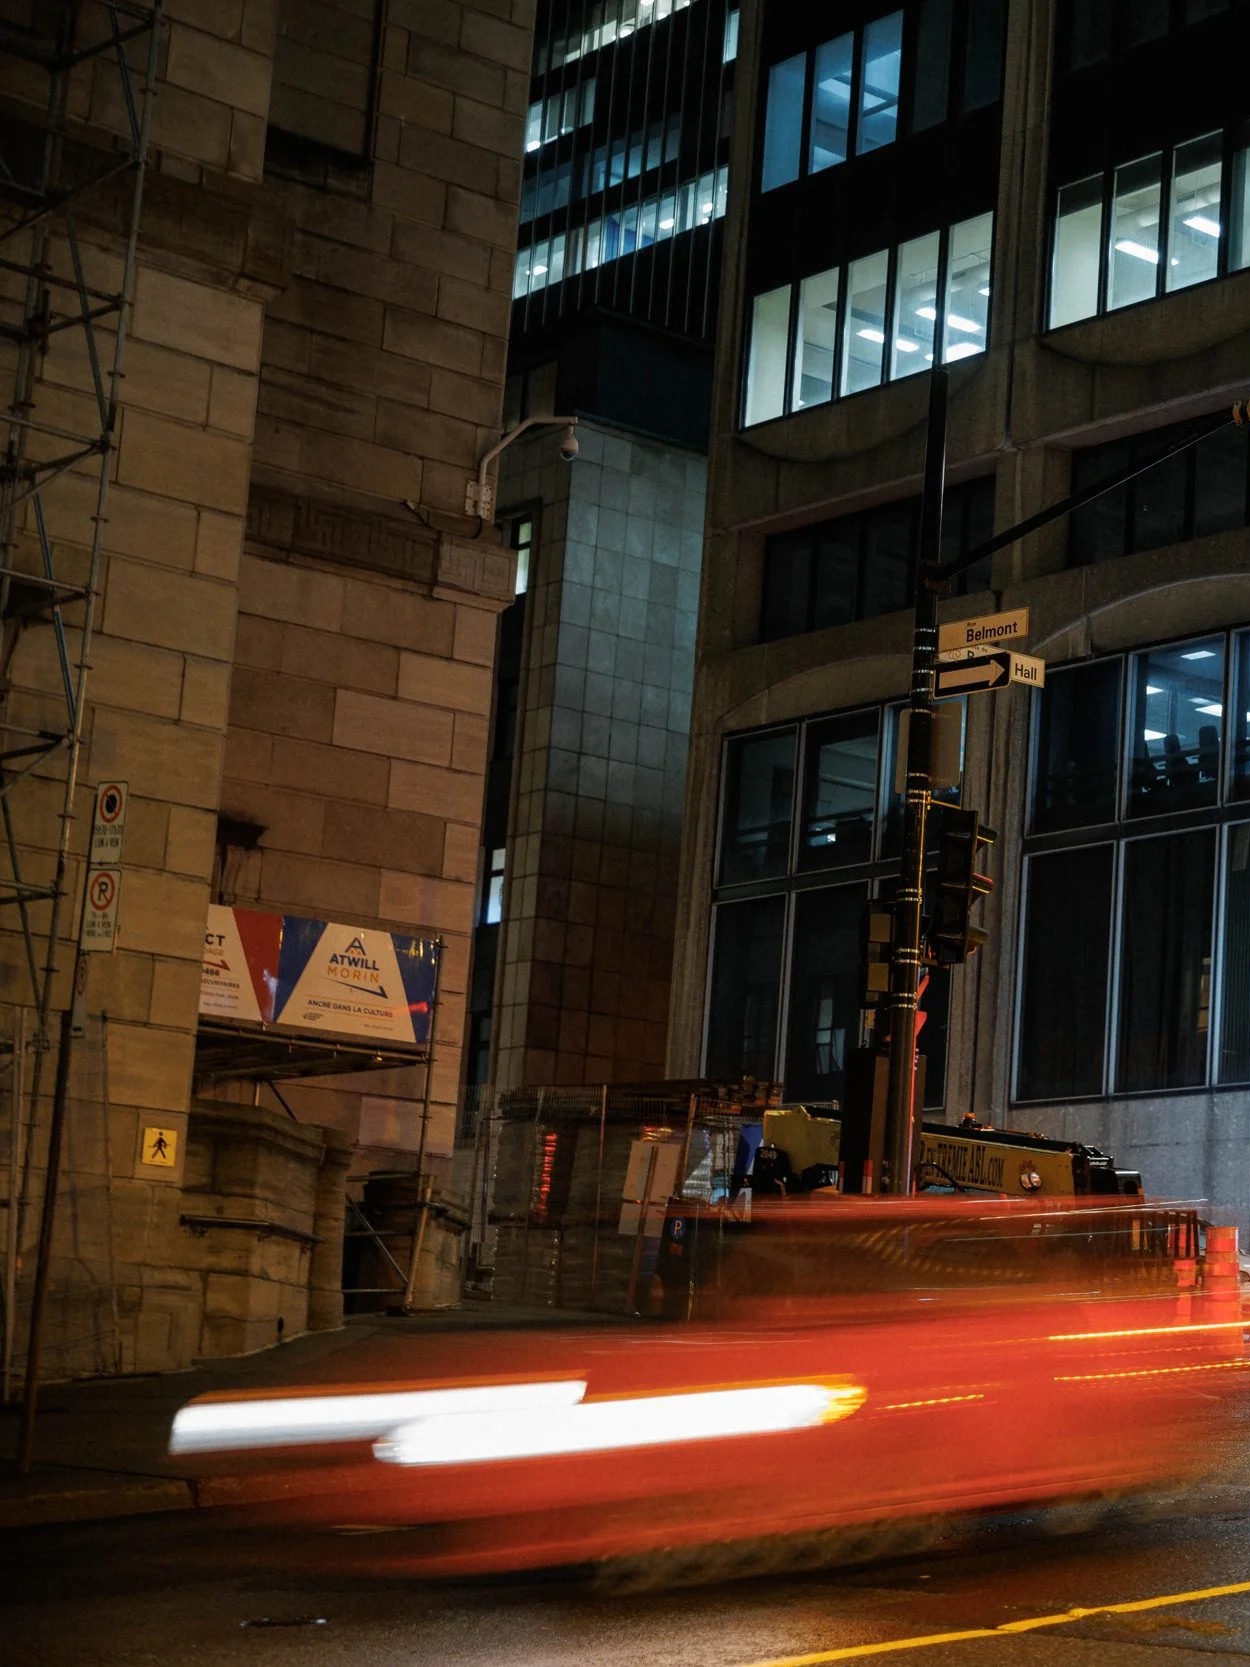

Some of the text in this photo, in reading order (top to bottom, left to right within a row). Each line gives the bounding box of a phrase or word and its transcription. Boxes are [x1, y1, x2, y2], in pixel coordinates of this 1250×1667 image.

[966, 622, 1018, 642] Belmont
[1014, 663, 1037, 681] Hall
[329, 953, 380, 971] ATWILL
[327, 965, 380, 983] MORIN
[332, 1003, 351, 1012] DANS
[353, 1006, 362, 1014] LA
[364, 1007, 393, 1018] CULTURE
